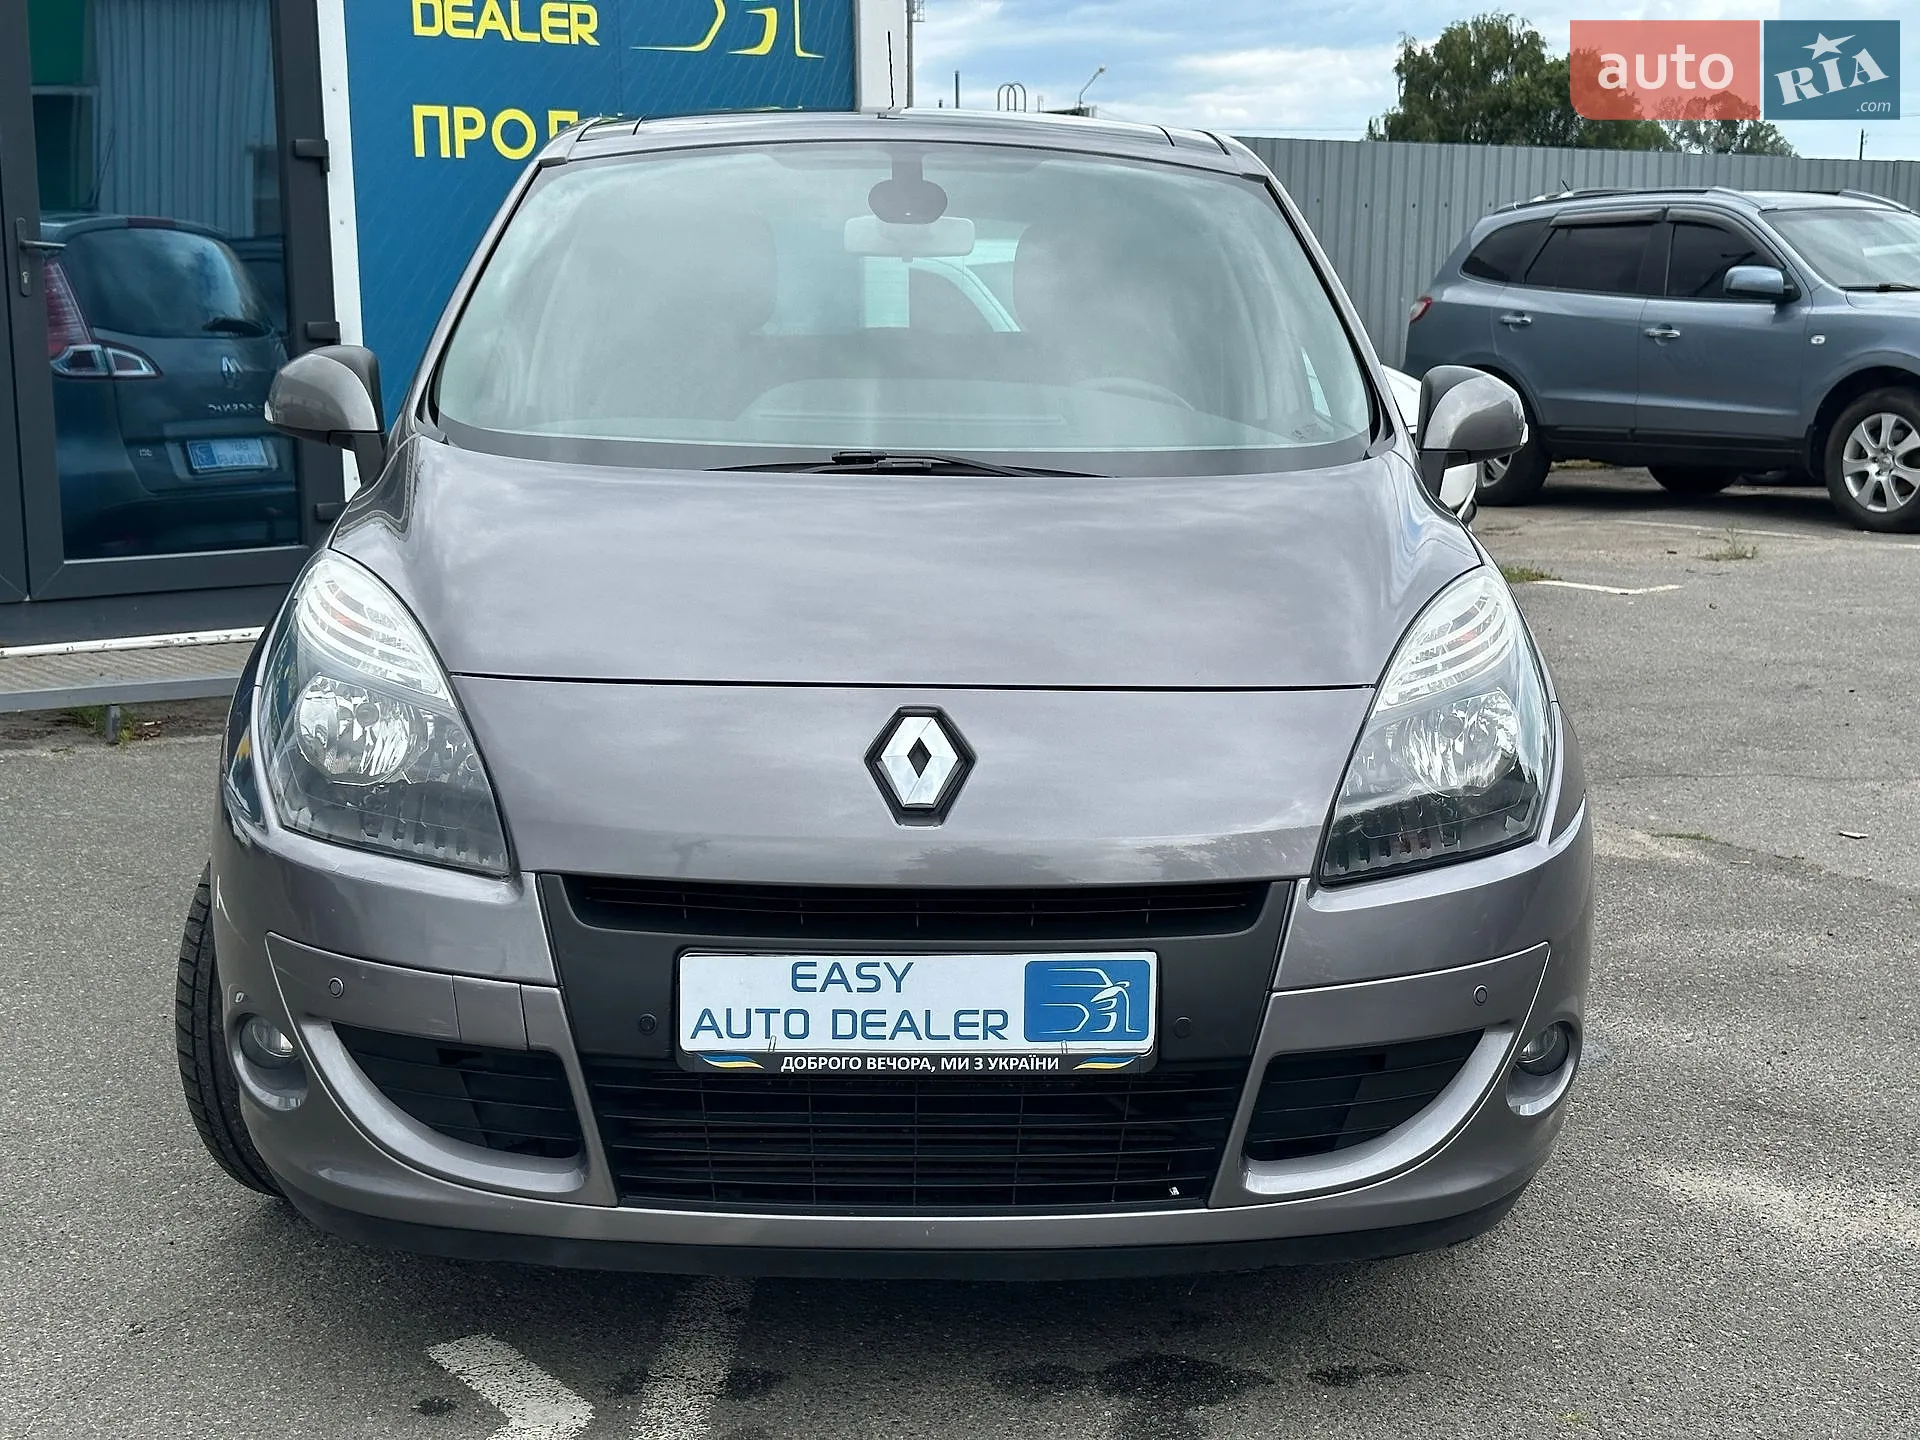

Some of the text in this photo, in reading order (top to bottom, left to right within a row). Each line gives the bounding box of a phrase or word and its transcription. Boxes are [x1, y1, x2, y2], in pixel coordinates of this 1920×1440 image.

[412, 0, 600, 47] DEALER
[790, 961, 915, 993] EASY
[690, 1008, 1010, 1041] AUTO DEALER
[780, 1055, 862, 1074] ДОБРОГО
[867, 1055, 936, 1073] ВЕЧОРА,
[941, 1056, 970, 1070] МИ
[987, 1054, 1060, 1071] УКРАЇНИ
